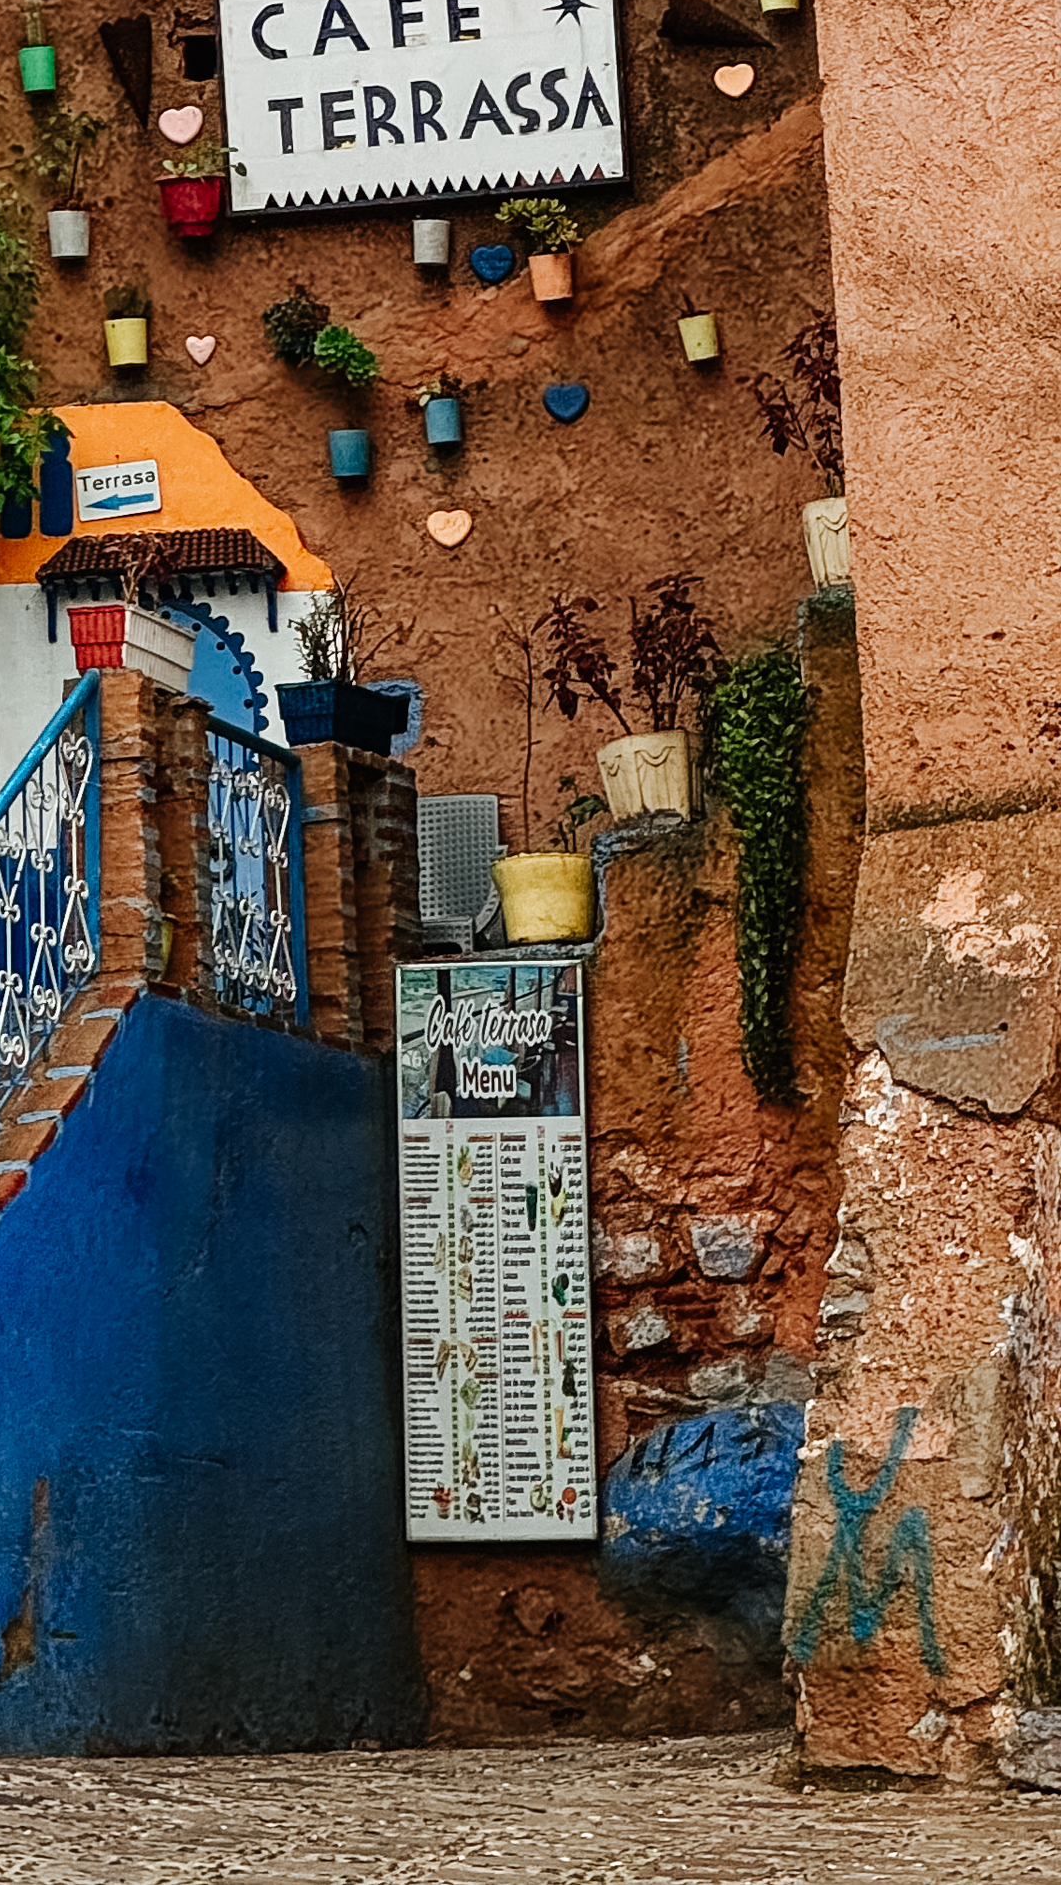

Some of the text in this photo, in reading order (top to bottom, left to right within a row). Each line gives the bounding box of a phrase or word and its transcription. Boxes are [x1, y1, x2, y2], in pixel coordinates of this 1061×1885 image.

[267, 67, 614, 155] TERRASSA
[77, 469, 157, 493] Terrasa
[426, 995, 552, 1051] Café terrasa
[460, 1059, 517, 1099] Menu
